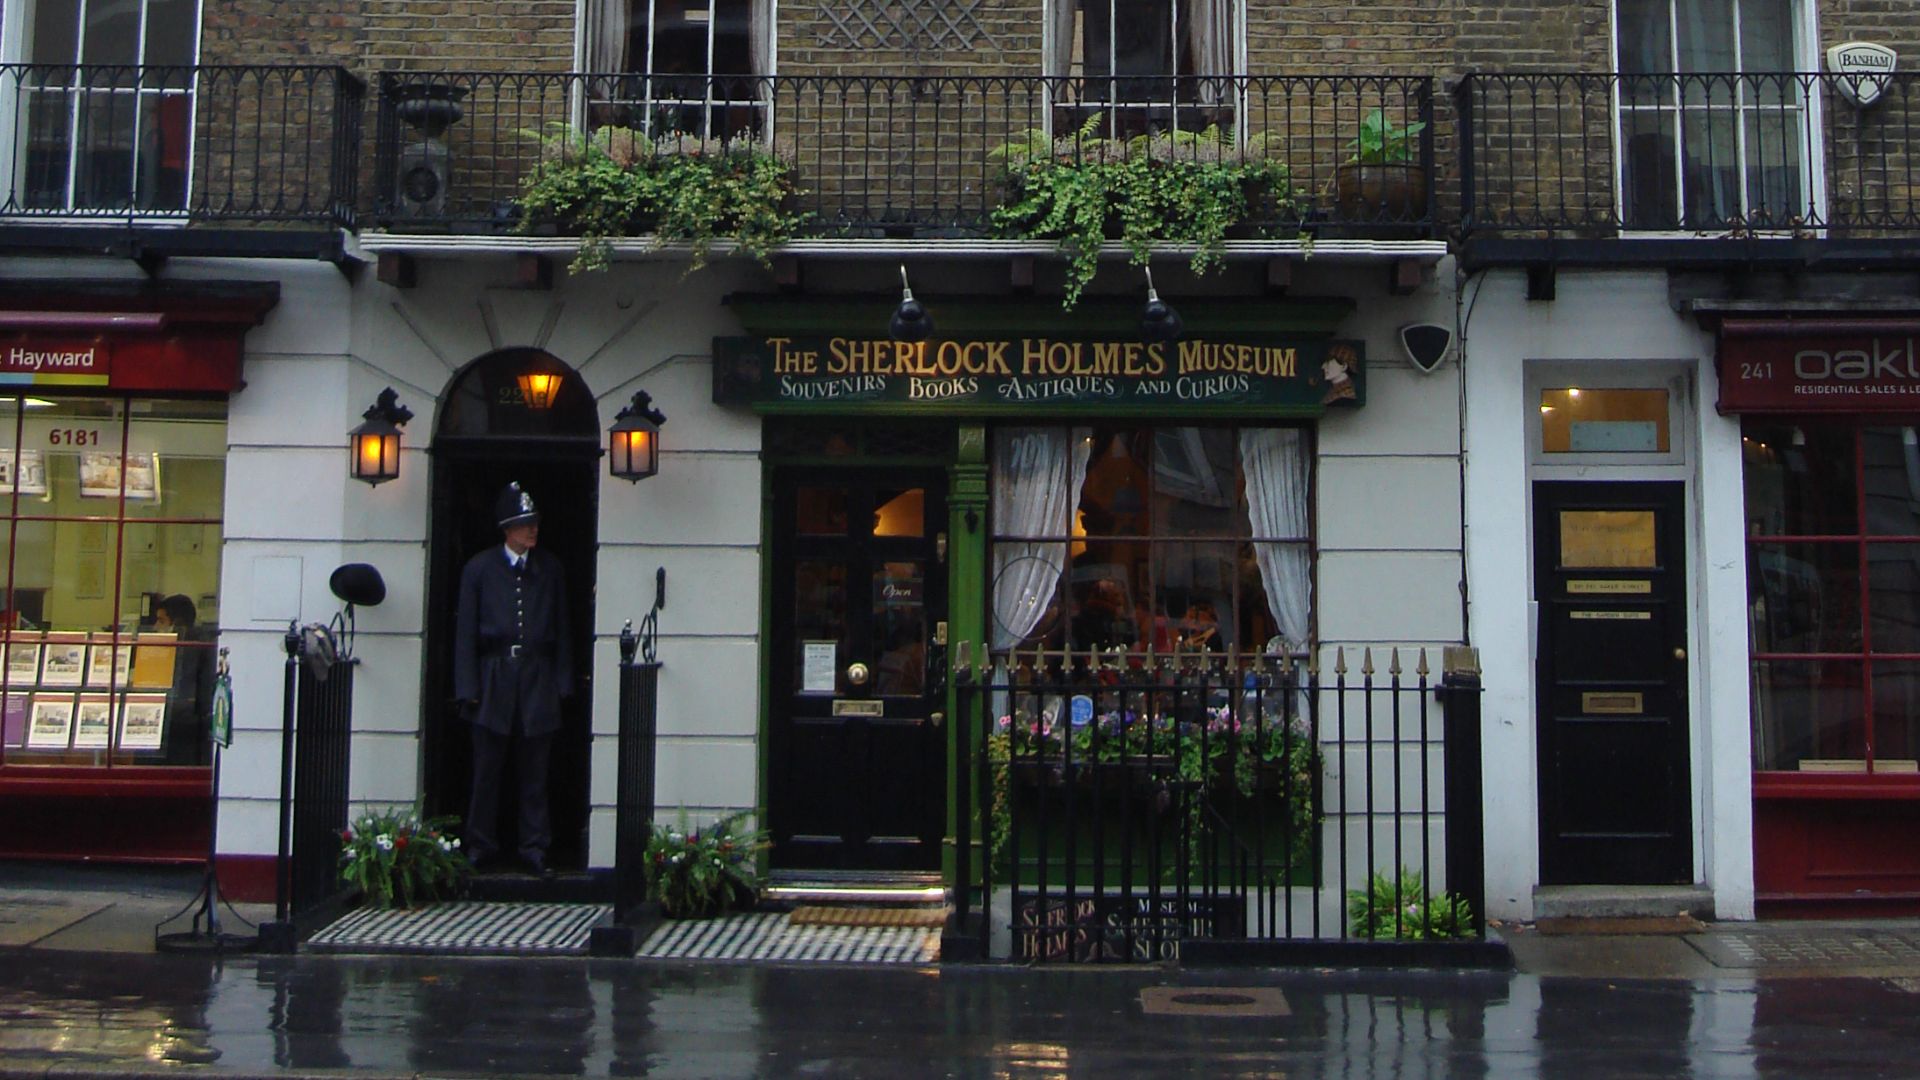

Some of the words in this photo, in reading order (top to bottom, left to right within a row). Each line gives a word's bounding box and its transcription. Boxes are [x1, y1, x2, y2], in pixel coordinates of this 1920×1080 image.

[1842, 54, 1889, 67] BANHAM
[10, 347, 95, 370] Hayward
[766, 337, 818, 374] THE
[827, 337, 1012, 375] SHERLOCK
[1021, 338, 1164, 375] HOLMES
[1177, 339, 1296, 377] MUSEUM
[1740, 361, 1773, 379] 241
[780, 375, 886, 399] SOUVENIRS
[909, 376, 978, 399] BOOKS
[998, 376, 1115, 399] ANTIQUES
[1135, 380, 1171, 395] AND
[1175, 374, 1249, 399] CURIOS
[1794, 384, 1860, 395] RESIDENTIAL
[1864, 384, 1896, 395] SALES
[1899, 384, 1906, 394] &
[49, 428, 99, 446] 6181
[882, 583, 912, 600] Open
